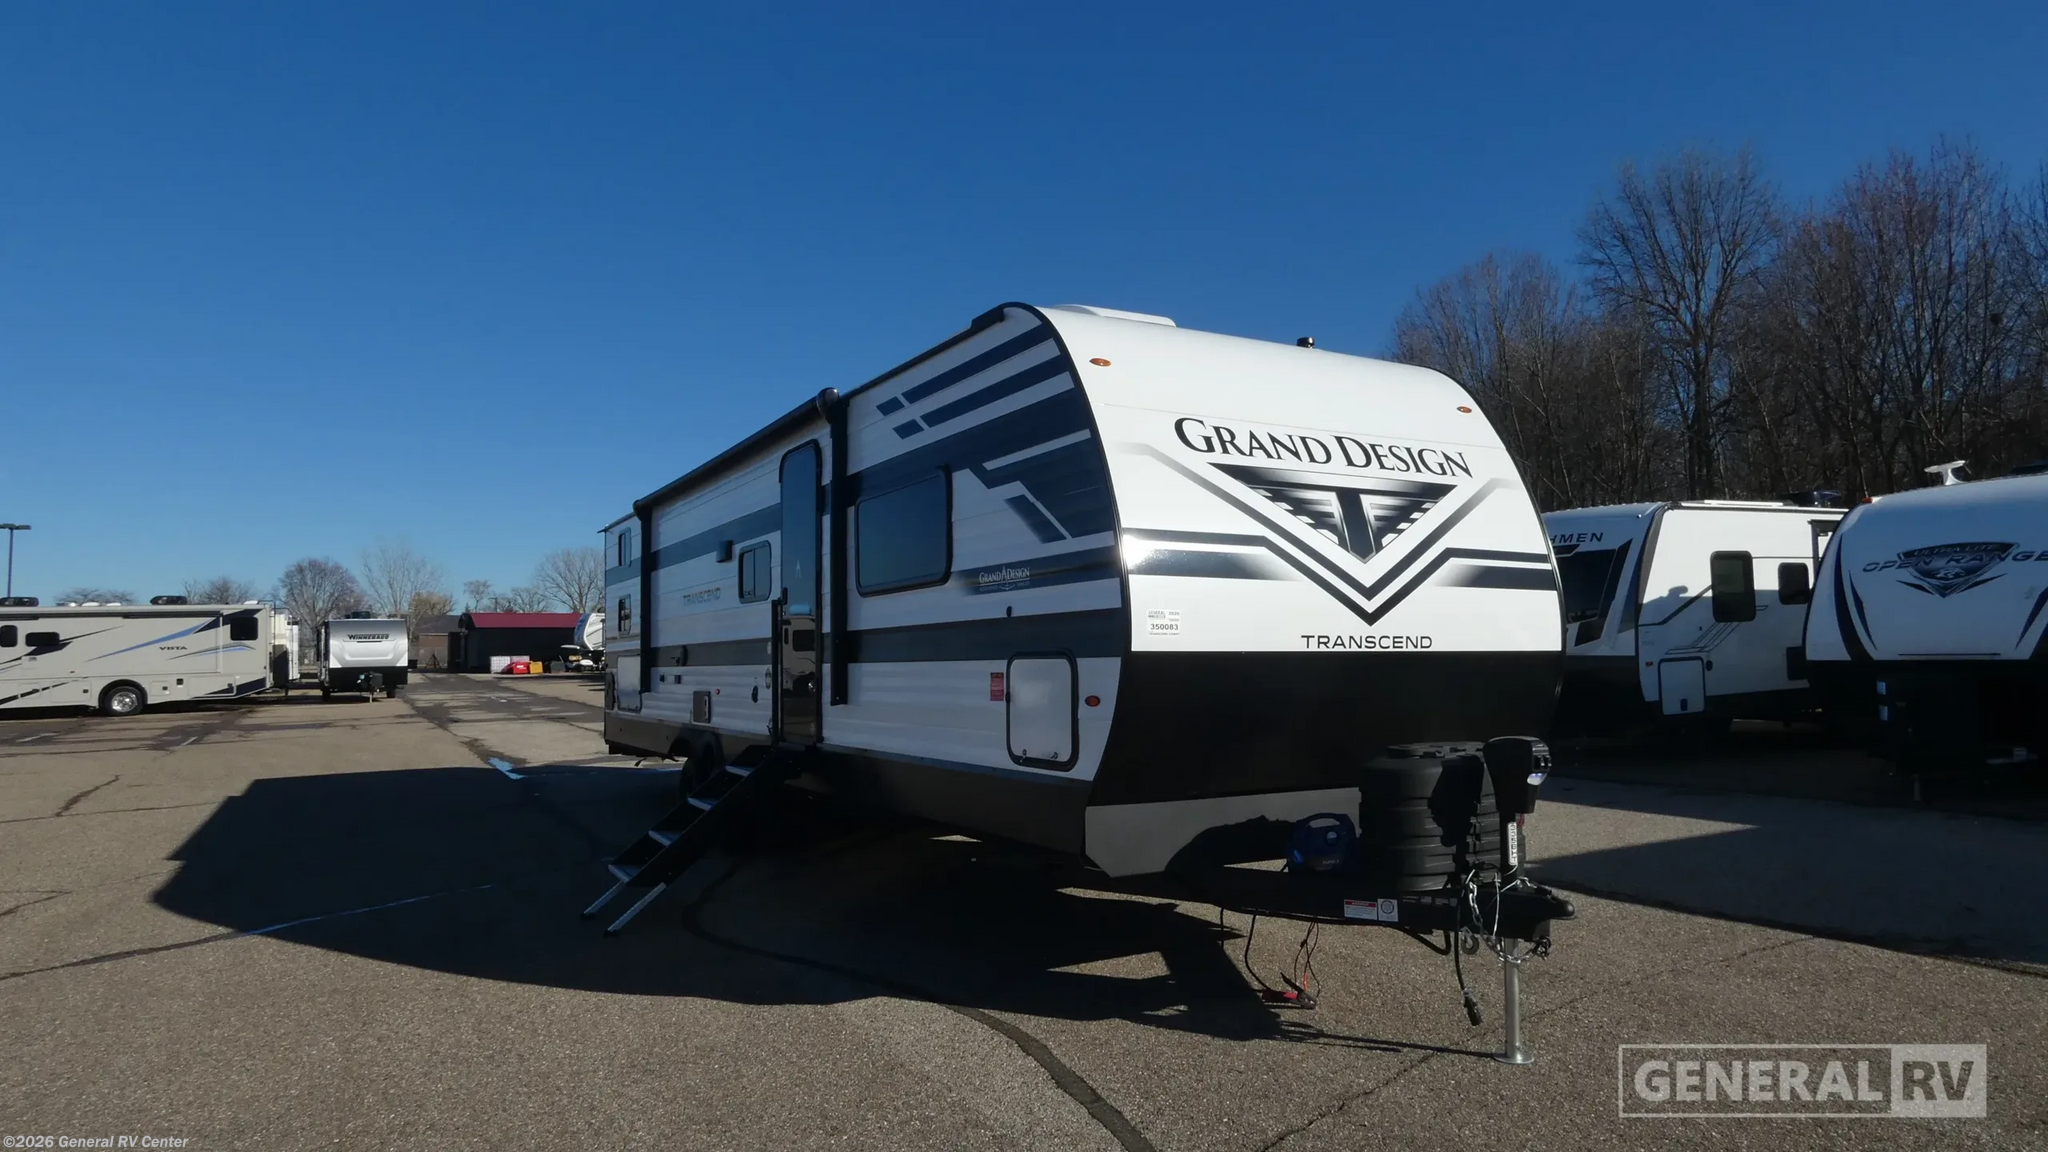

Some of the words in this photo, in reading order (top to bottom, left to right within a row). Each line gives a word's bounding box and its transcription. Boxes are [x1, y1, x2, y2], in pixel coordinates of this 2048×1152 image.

[1174, 417, 1332, 465] GRAND
[1334, 434, 1474, 479] DESIGN
[1914, 546, 1960, 556] ULTRA
[1965, 544, 1996, 552] LITE
[1862, 556, 1935, 573] OPEN
[1945, 550, 2048, 565] RANGE
[979, 571, 1002, 583] GRAND
[1006, 567, 1030, 580] DESIGN
[1150, 623, 1179, 631] 350083
[1301, 635, 1433, 650] TRANSCEND
